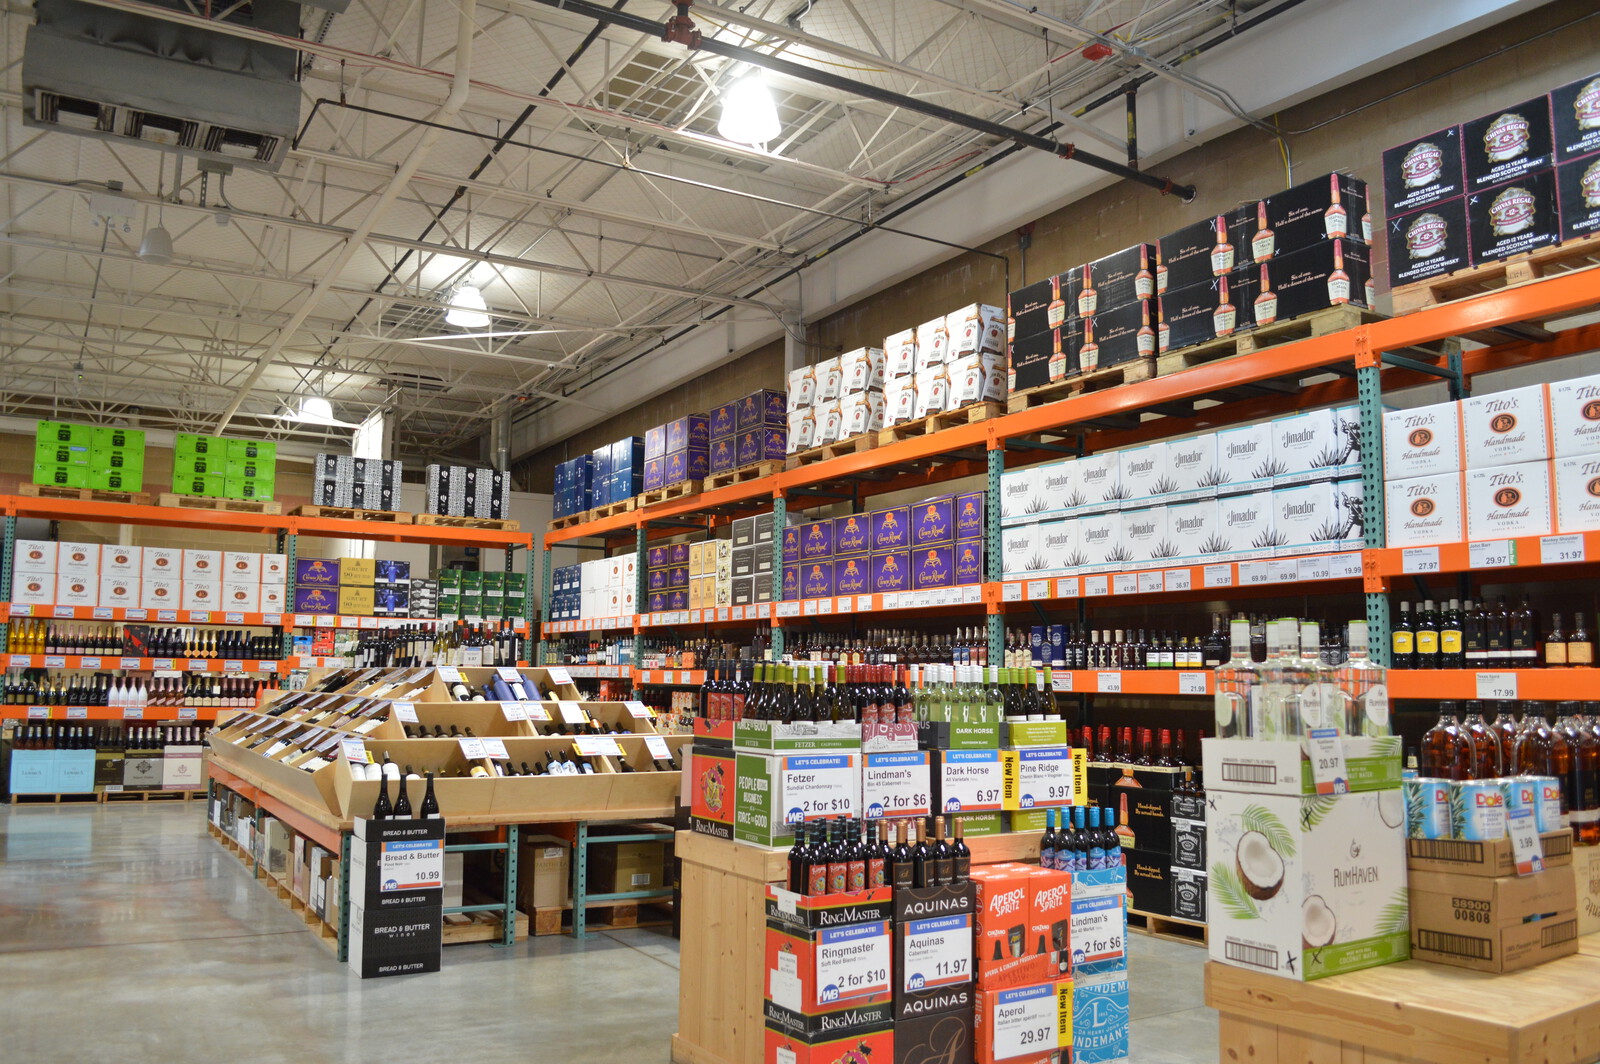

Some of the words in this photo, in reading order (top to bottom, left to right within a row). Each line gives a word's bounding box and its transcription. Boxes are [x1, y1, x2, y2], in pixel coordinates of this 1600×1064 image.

[1485, 129, 1506, 142] CHIVAS
[1507, 122, 1526, 133] REGAL
[1511, 158, 1527, 167] YEARS
[1476, 173, 1499, 184] BLENDED
[1500, 168, 1521, 177] SCOTCH
[1522, 159, 1543, 170] WHISKY
[1491, 204, 1511, 215] CHIVAS
[1512, 196, 1532, 206] REGAL
[1482, 247, 1504, 256] BLENDED
[1505, 241, 1527, 251] SCOTCH
[1528, 234, 1549, 245] WHISKY
[1485, 397, 1519, 413] Tito's
[1284, 428, 1316, 448] Jimador
[1484, 434, 1525, 447] Handmade
[1402, 449, 1441, 460] Handmade
[1489, 471, 1524, 487] Tito's
[1487, 507, 1529, 521] Handmade
[1404, 519, 1443, 529] Handmade
[918, 527, 932, 539] Crown
[930, 524, 945, 538] Royal
[1485, 556, 1506, 565] 29.97
[1560, 551, 1582, 560] 31.97
[1418, 562, 1438, 570] 27.97
[919, 572, 932, 583] Crown
[930, 570, 947, 581] Royal
[1312, 570, 1329, 578] 10.99
[1176, 581, 1190, 589] 36.97
[1493, 689, 1514, 697] 17.99
[1004, 756, 1013, 775] New
[1020, 764, 1036, 773] Pine
[1038, 763, 1059, 773] Ridge
[1074, 754, 1082, 772] New
[1319, 757, 1339, 769] 20.97
[868, 770, 912, 779] Lindman's
[946, 766, 964, 775] Dark
[966, 766, 989, 775] Horse
[787, 774, 815, 783] Fetzer
[1074, 775, 1082, 795] Item
[1004, 777, 1013, 799] Item
[1049, 786, 1070, 798] 9.97
[883, 796, 890, 807] 2
[894, 795, 909, 806] for
[914, 794, 926, 806] $6
[977, 790, 999, 802] 6.97
[1020, 797, 1034, 807] WB
[1475, 793, 1503, 807] Dole
[803, 801, 810, 812] 2
[813, 800, 827, 811] for
[832, 799, 850, 810] $10
[946, 801, 961, 811] WB
[788, 812, 804, 822] WB
[868, 808, 883, 817] WB
[1519, 837, 1533, 848] 3.99
[416, 871, 439, 880] 10.99
[989, 887, 1025, 911] APEROL
[1034, 884, 1068, 907] APEROL
[904, 897, 969, 915] AQUINAS
[996, 899, 1020, 917] SPRITZ
[1040, 895, 1063, 912] SPRITZ
[1453, 898, 1490, 911] 38900
[1071, 914, 1108, 927] Lindman's
[1454, 909, 1490, 924] 00808
[930, 919, 960, 929] CELEBRATE!
[845, 927, 877, 937] CELEBRATE!
[910, 936, 945, 950] Aquinas
[1084, 942, 1090, 953] 2
[1093, 940, 1107, 951] for
[1110, 936, 1121, 949] $6
[821, 942, 875, 960] Ringmaster
[909, 949, 929, 957] Cabernet
[935, 959, 968, 976] 11.97
[838, 976, 845, 988] 2
[848, 972, 864, 986] for
[867, 968, 886, 984] $10
[909, 977, 924, 988] WB
[822, 989, 839, 1001] WB
[1005, 991, 1017, 999] LET'S
[1018, 988, 1046, 997] CELEBRATE!
[903, 993, 968, 1014] AQUINAS
[1059, 988, 1067, 1013] New
[998, 1005, 1025, 1018] Aperol
[1059, 1014, 1067, 1034] Item
[1021, 1027, 1050, 1045] 29.97
